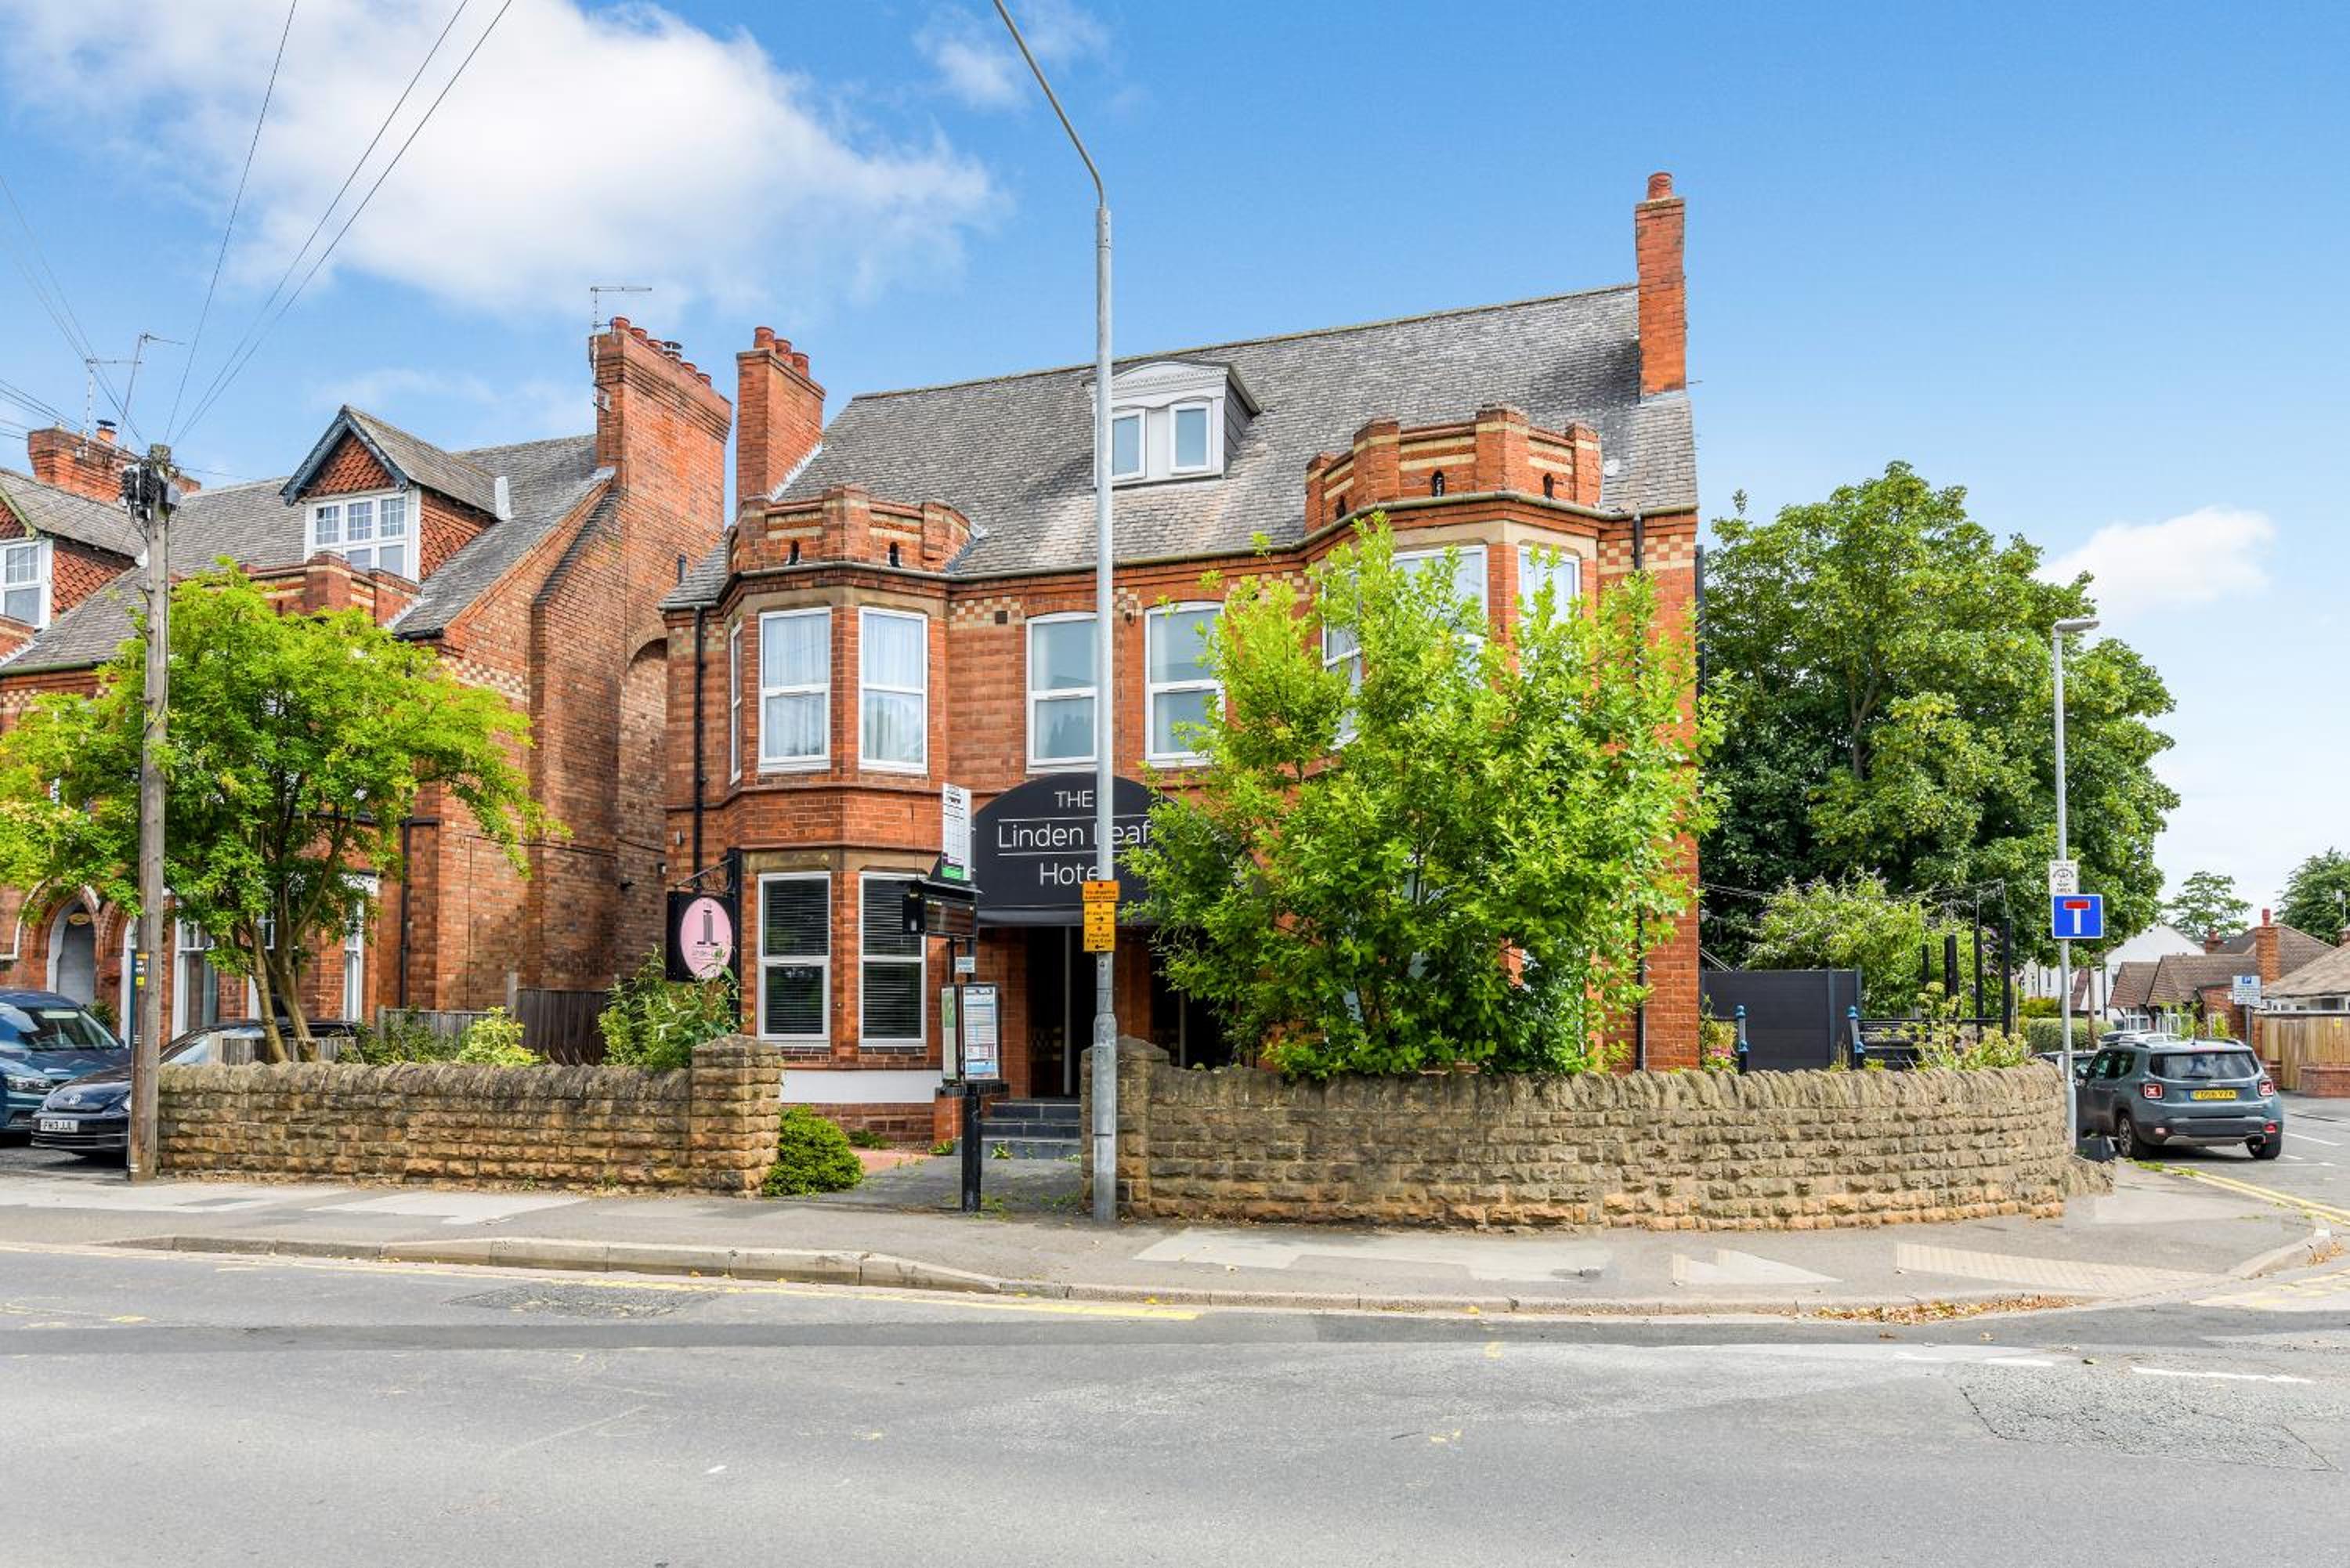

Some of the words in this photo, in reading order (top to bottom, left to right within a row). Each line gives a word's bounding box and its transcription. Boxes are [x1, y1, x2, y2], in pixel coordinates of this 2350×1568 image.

[1054, 790, 1094, 808] THE
[998, 823, 1083, 848] Linden
[1039, 862, 1099, 886] Hote
